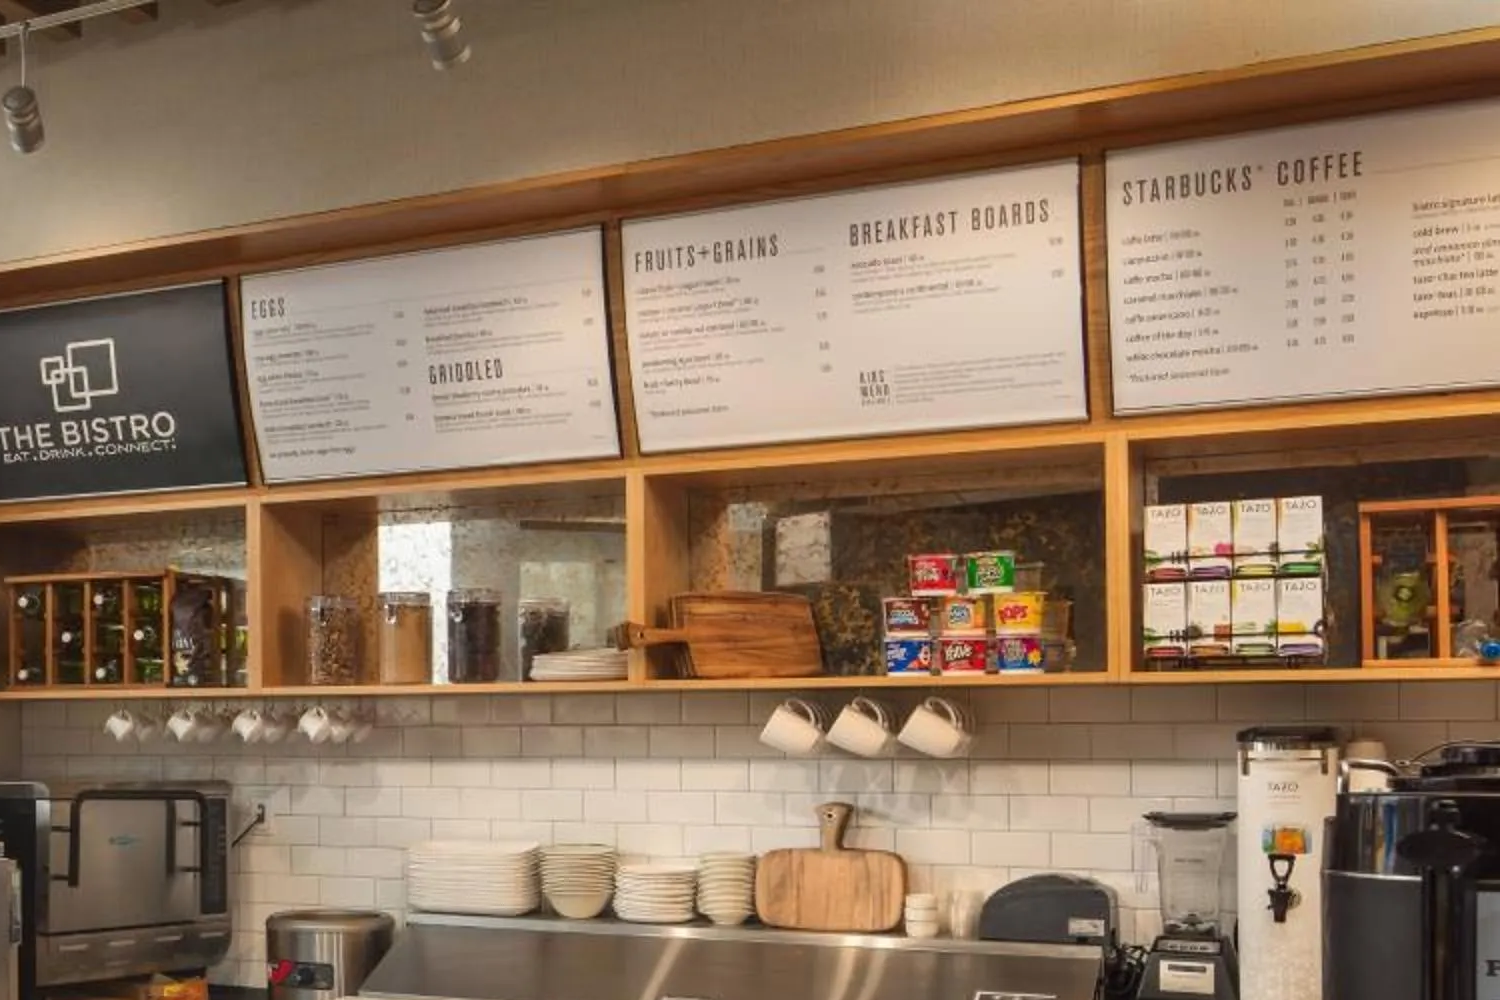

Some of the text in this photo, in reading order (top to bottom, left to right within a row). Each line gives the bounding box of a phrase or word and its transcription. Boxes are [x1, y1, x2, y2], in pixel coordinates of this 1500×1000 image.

[1277, 151, 1363, 187] COFFEE
[849, 198, 1050, 247] BREAKFAST BOARDS
[634, 233, 780, 273] FRUITS+GRAINS
[250, 297, 286, 320] EGGS
[428, 357, 504, 385] GRIDDLED
[61, 411, 176, 446] BISTRO
